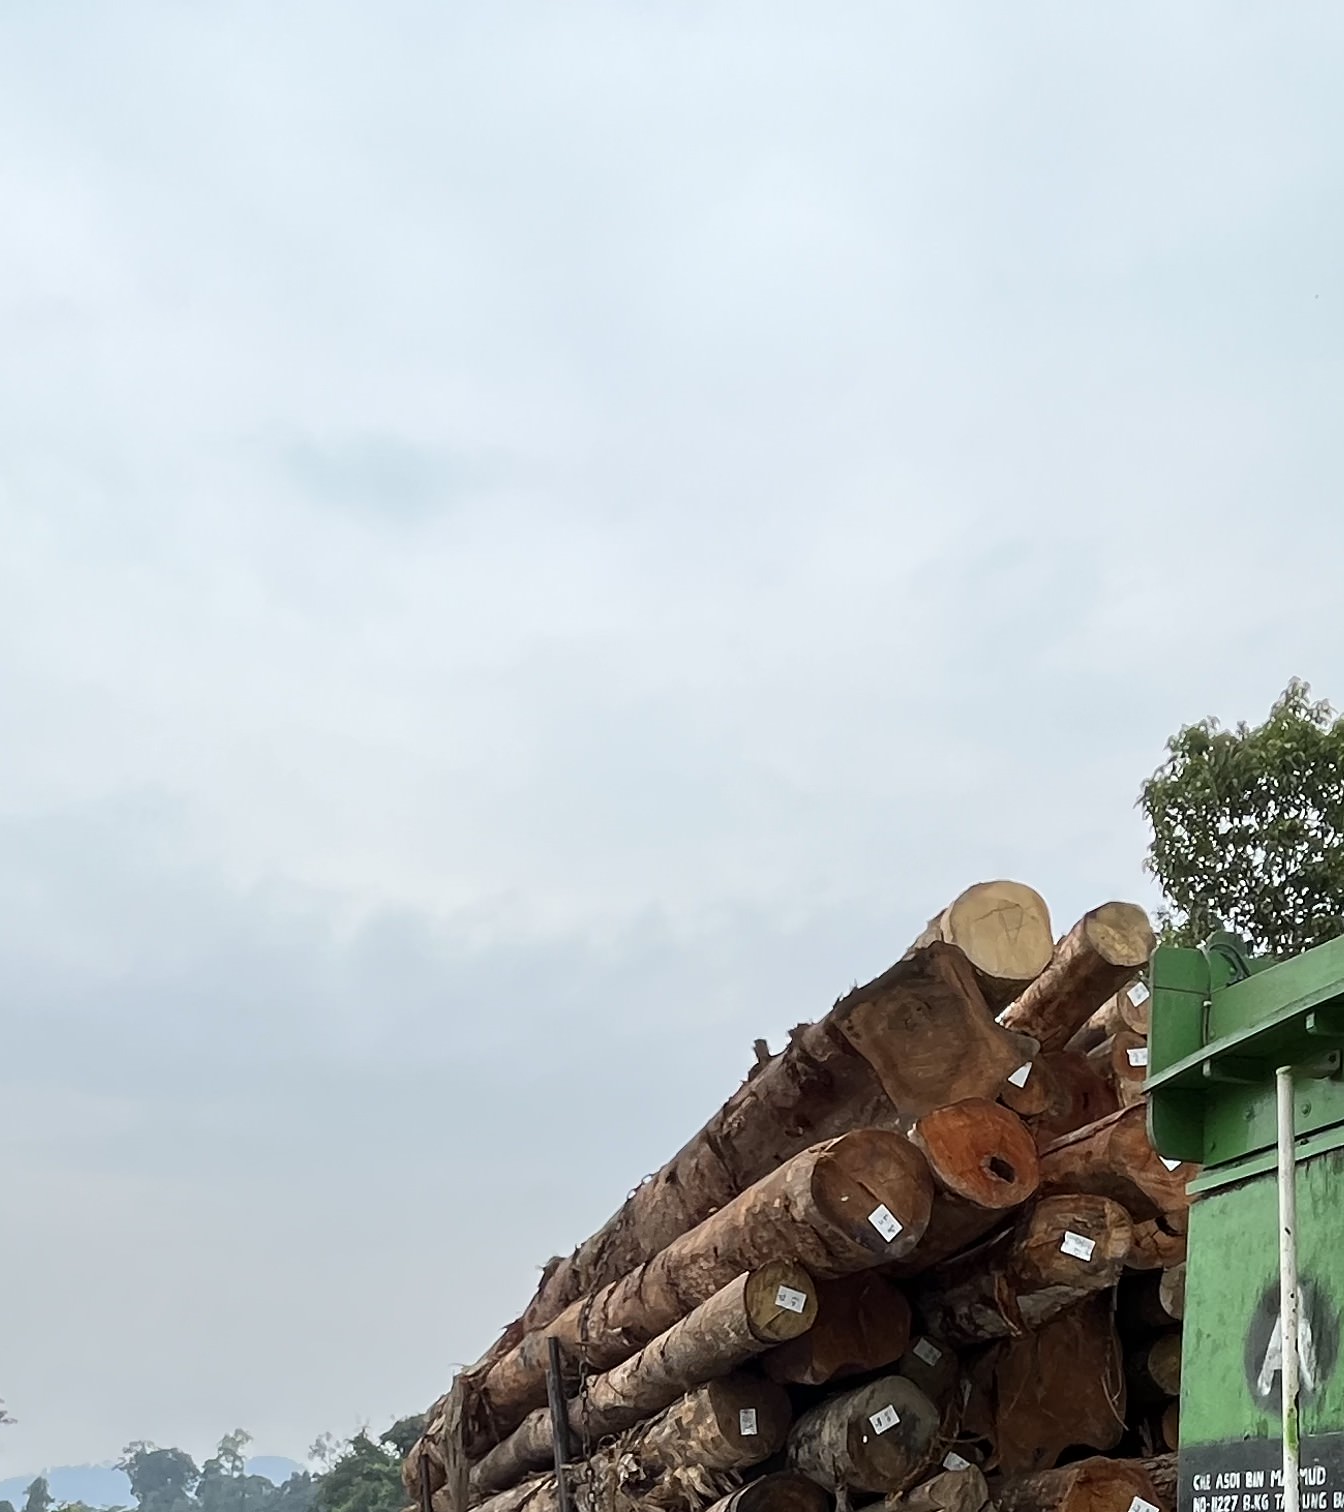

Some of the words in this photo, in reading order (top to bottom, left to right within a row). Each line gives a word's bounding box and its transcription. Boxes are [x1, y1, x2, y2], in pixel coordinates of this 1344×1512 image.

[1193, 1474, 1211, 1490] CHE
[1245, 1471, 1264, 1488] BIN
[1270, 1466, 1326, 1488] MMUD
